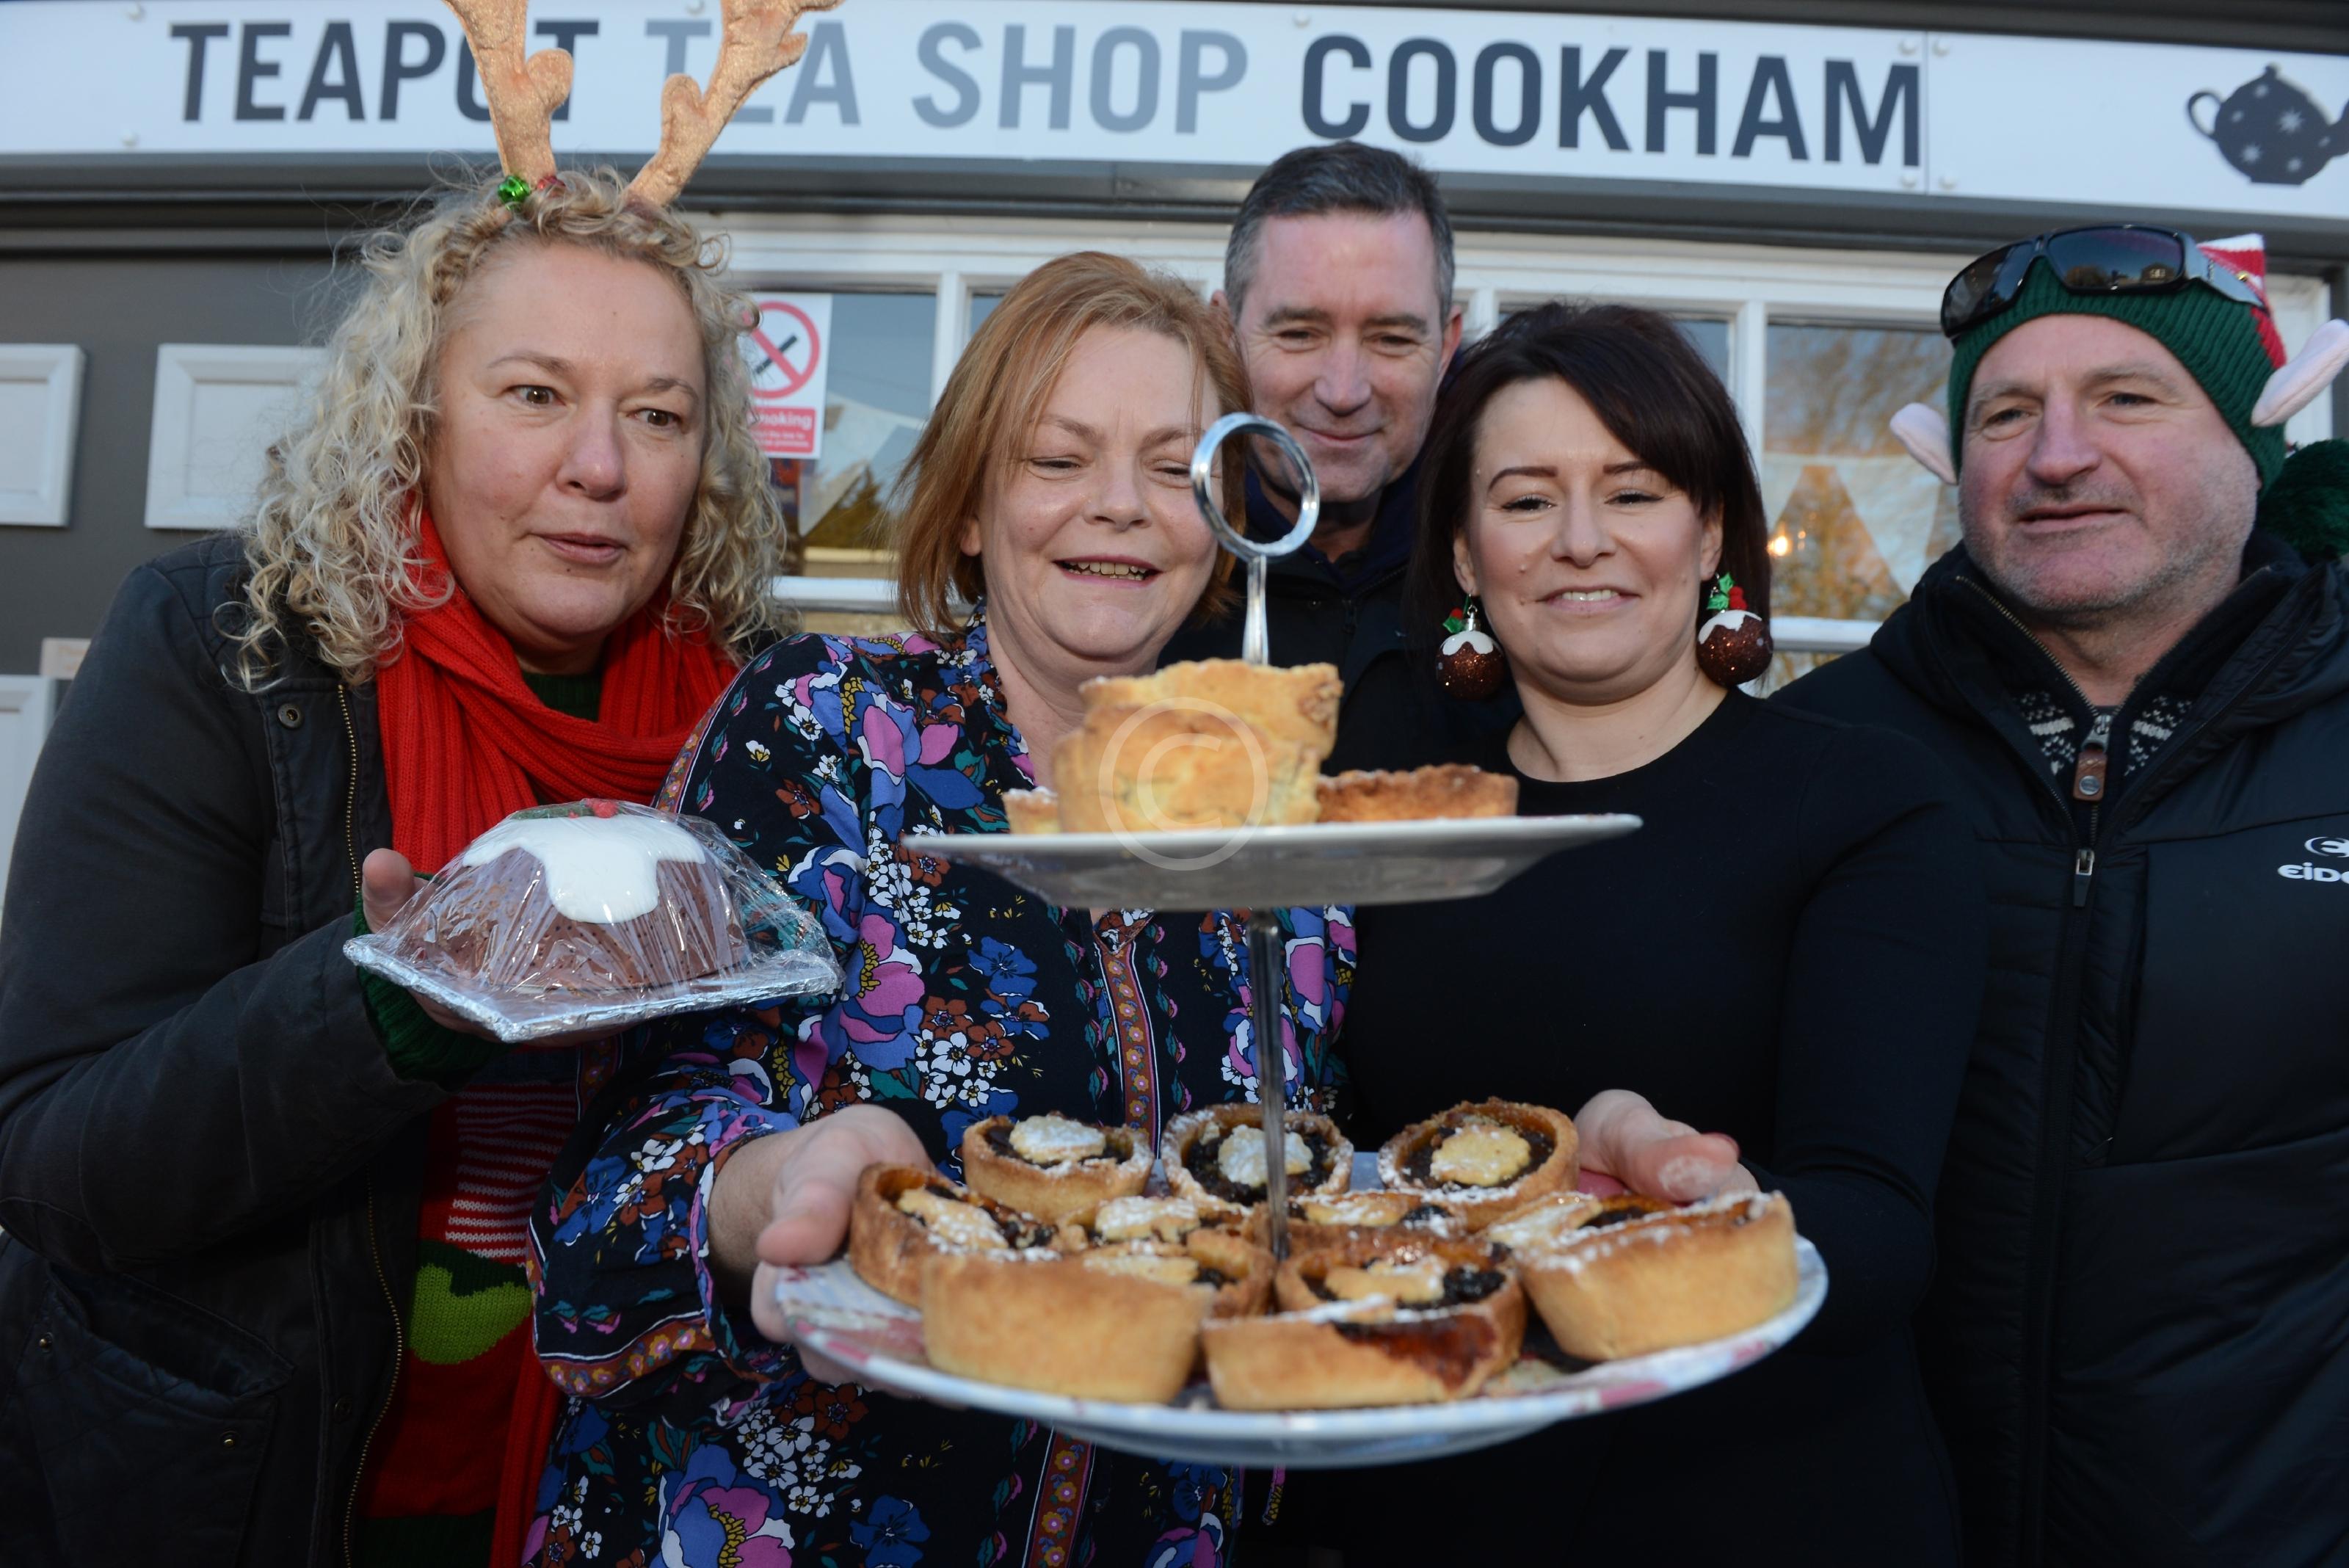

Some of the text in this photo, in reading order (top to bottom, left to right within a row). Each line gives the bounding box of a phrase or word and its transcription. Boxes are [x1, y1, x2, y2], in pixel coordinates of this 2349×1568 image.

[645, 20, 861, 126] TA
[911, 20, 1248, 135] SHOP
[1301, 34, 1921, 167] COOKHAM
